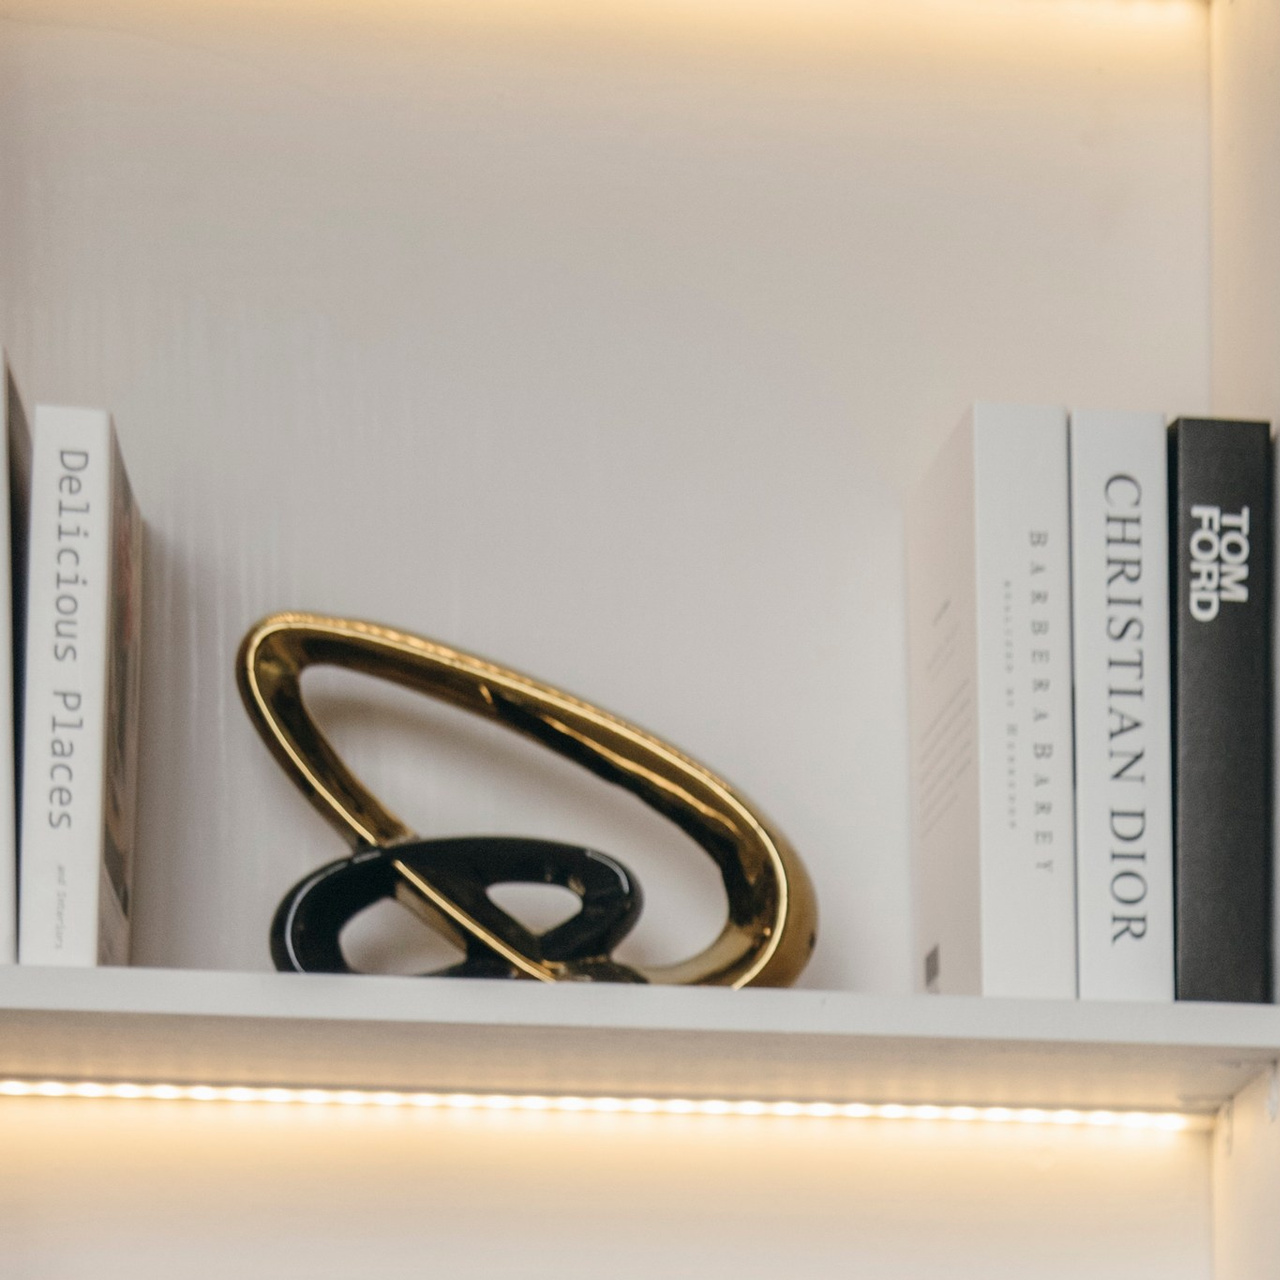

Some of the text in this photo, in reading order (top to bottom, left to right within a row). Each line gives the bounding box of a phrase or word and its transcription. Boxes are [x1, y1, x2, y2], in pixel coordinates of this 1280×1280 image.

[49, 449, 90, 830] Delicious Places
[1189, 504, 1221, 623] FORD
[1221, 505, 1250, 603] TOM
[1105, 472, 1149, 945] CHRISTIAN DIOR
